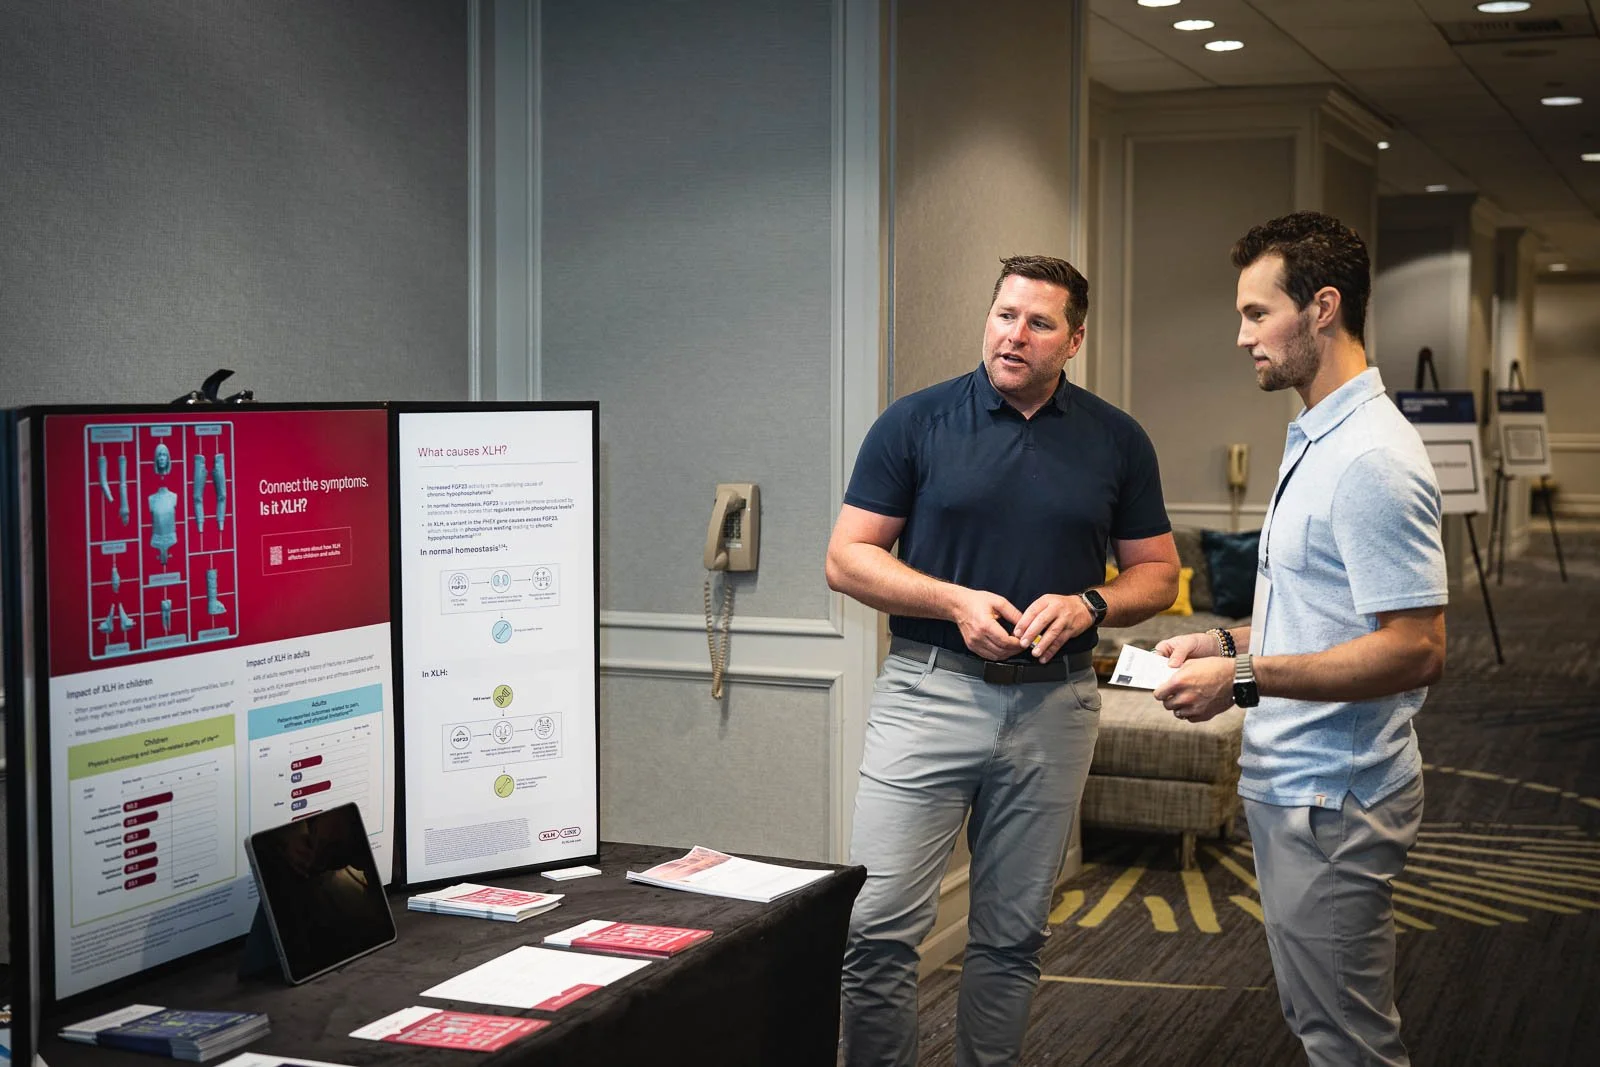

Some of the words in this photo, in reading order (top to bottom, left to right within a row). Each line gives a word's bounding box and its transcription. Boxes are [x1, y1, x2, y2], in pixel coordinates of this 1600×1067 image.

[418, 447, 443, 457] What
[446, 448, 479, 456] causes
[482, 445, 507, 455] XLH?
[259, 478, 301, 494] Connect
[302, 477, 318, 491] the
[320, 476, 368, 494] symptoms.
[260, 501, 270, 516] Is
[271, 501, 279, 514] it
[280, 498, 308, 514] XLH?
[429, 547, 453, 555] normal
[246, 658, 266, 668] Impact
[273, 653, 286, 663] XLH
[294, 650, 310, 659] adults
[67, 688, 91, 699] Impact
[93, 685, 100, 694] of
[102, 683, 116, 693] XLH
[118, 682, 124, 690] in
[126, 678, 153, 689] children
[277, 712, 310, 723] Patient-reported
[312, 715, 328, 723] physical
[144, 737, 168, 746] Children
[88, 759, 109, 768] Physical
[110, 753, 139, 763] functioning
[150, 744, 184, 754] health-related
